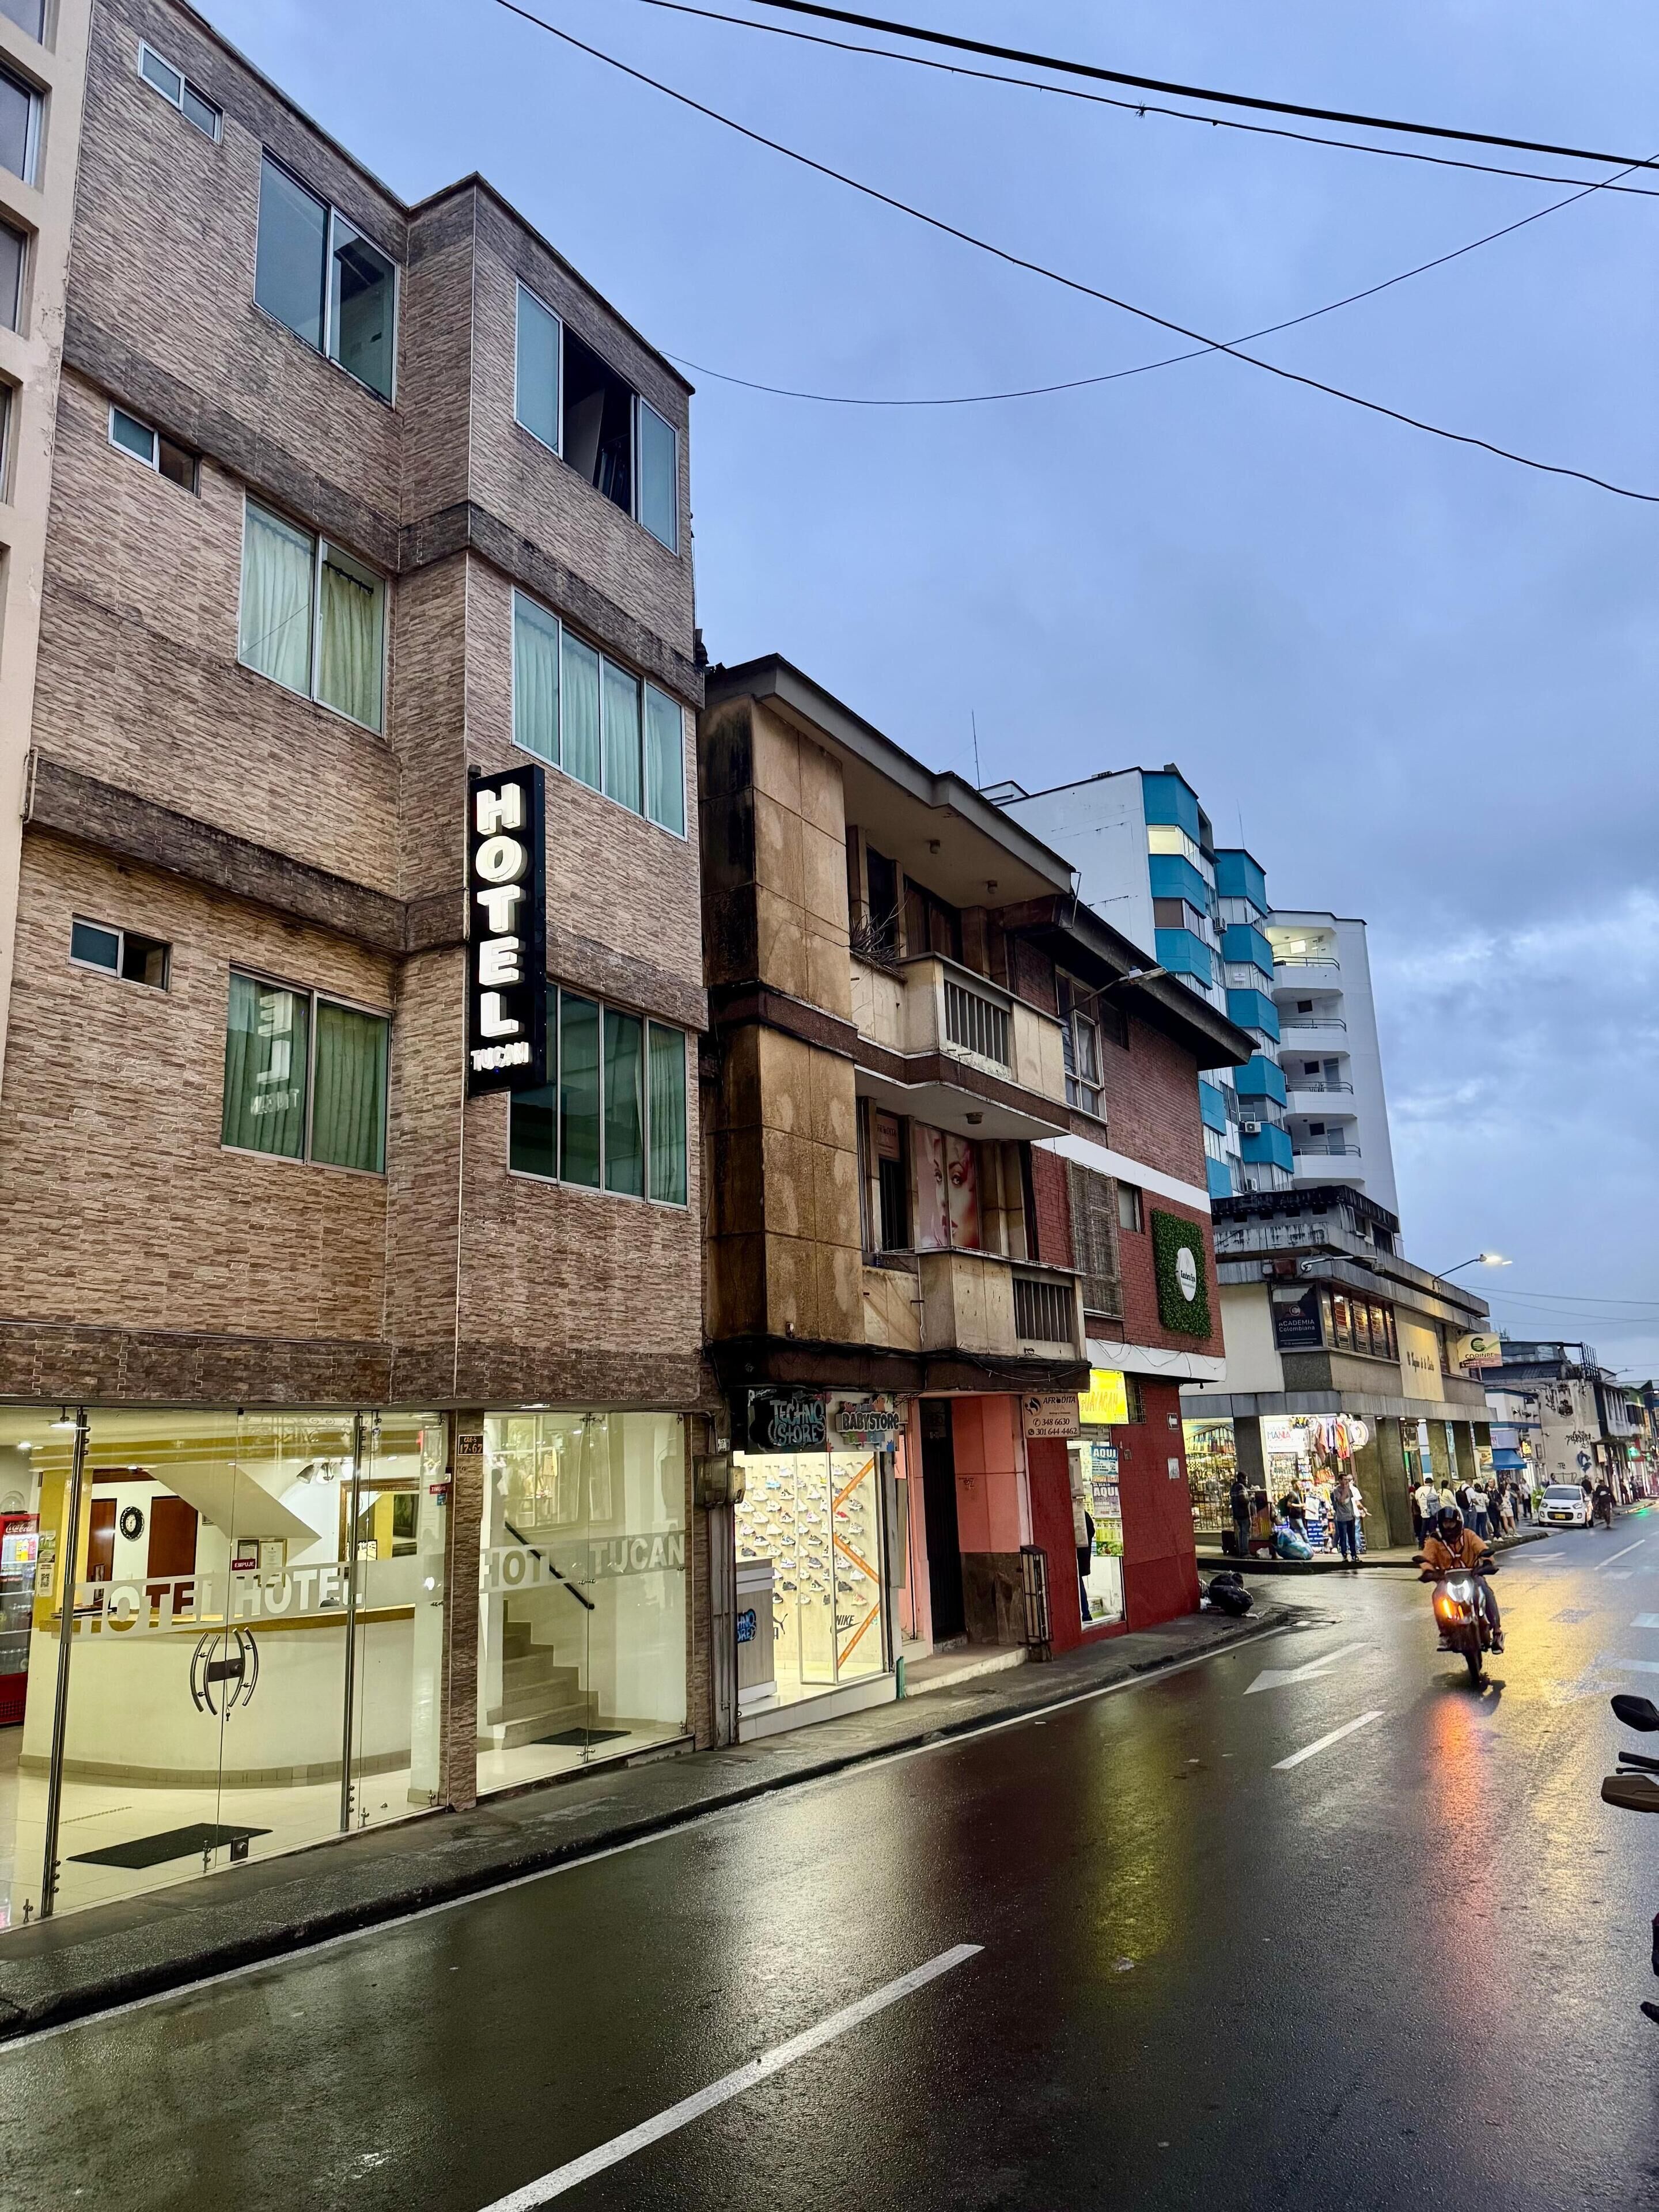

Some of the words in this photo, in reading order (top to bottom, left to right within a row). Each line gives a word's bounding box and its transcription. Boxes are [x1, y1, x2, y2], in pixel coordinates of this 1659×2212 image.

[476, 782, 522, 1037] HOTEL
[470, 1041, 529, 1071] TUCAN
[770, 1399, 824, 1426] TECHNO
[777, 1423, 819, 1446] STORE
[1093, 1448, 1116, 1457] AQUI
[1093, 1486, 1118, 1497] AQUI
[589, 1533, 684, 1575] TUCAN
[74, 1578, 224, 1635] HOTEL
[233, 1565, 362, 1618] HOTEL
[836, 1615, 855, 1626] NIKE
